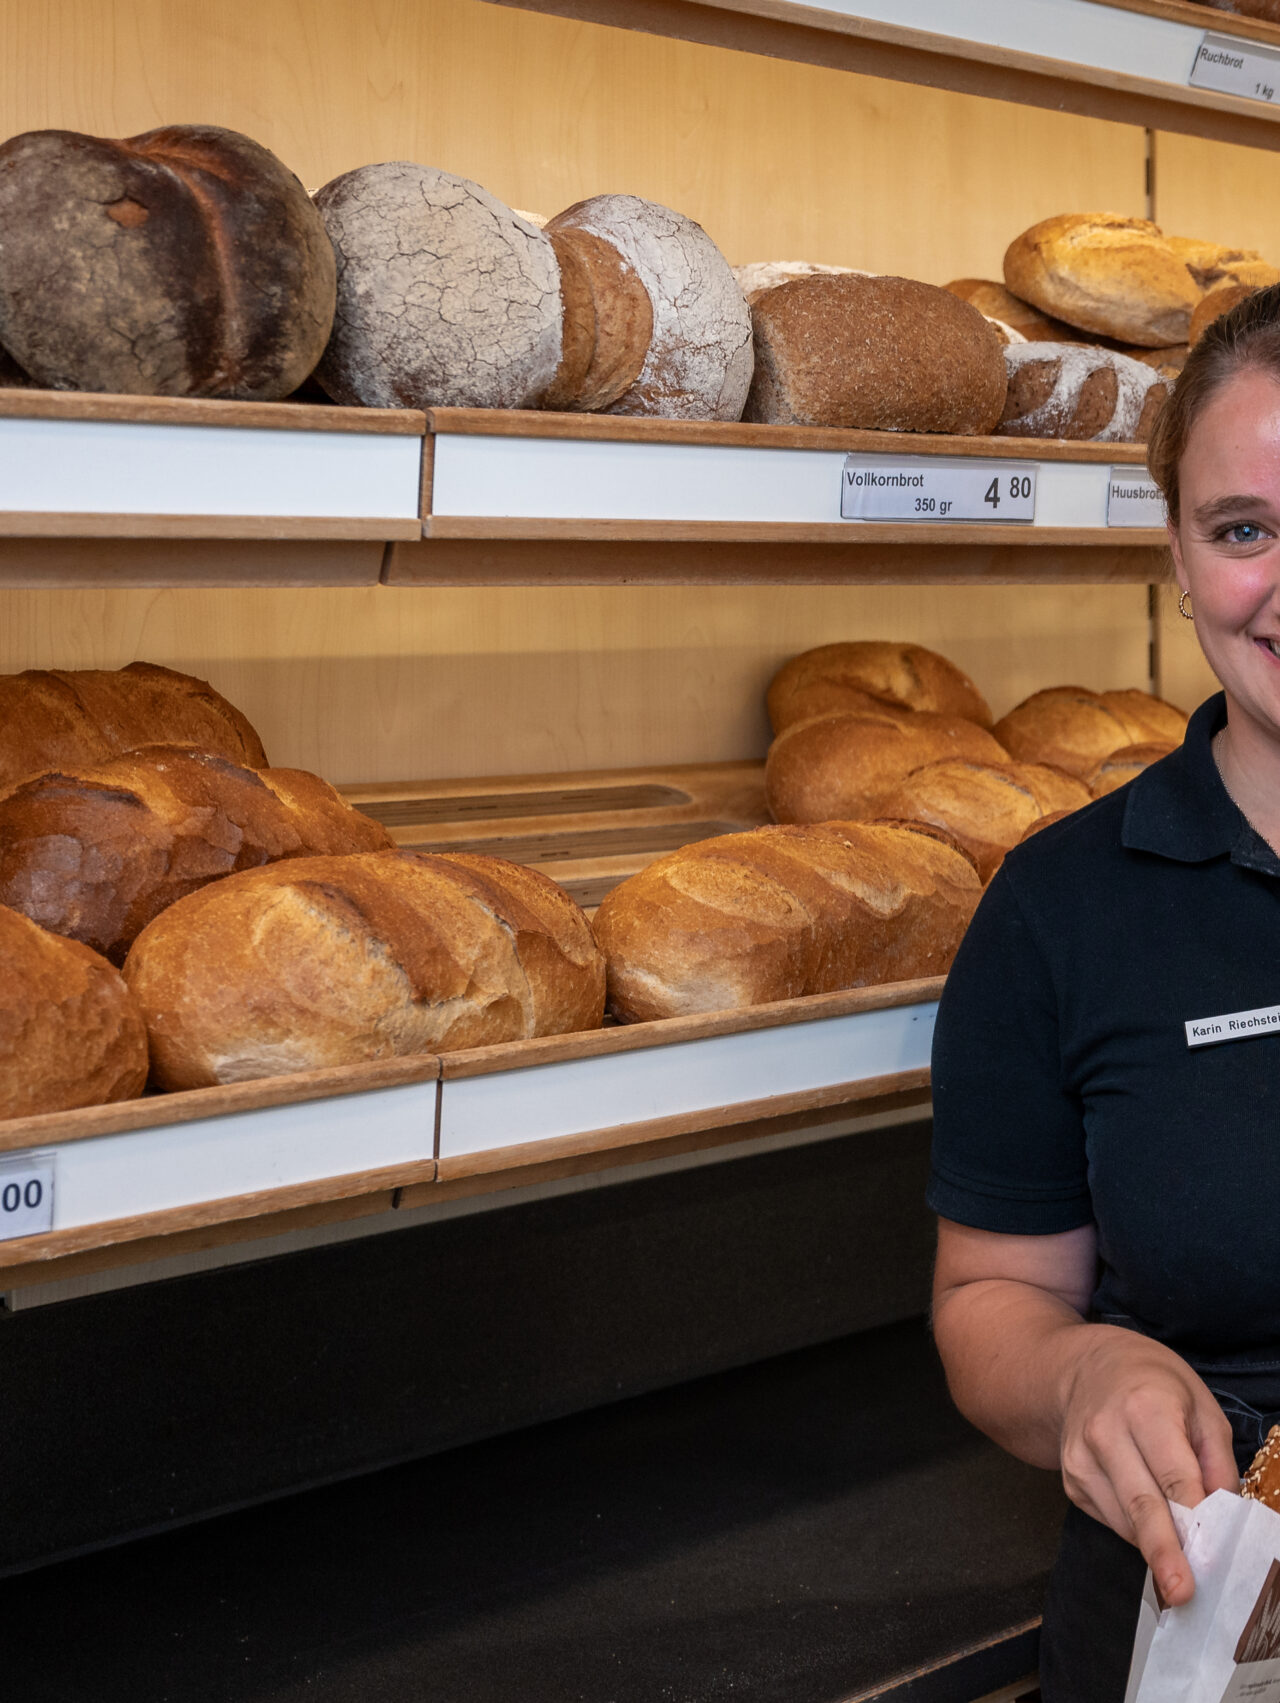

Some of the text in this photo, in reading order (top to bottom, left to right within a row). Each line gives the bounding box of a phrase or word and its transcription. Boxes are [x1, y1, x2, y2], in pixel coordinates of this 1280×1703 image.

[1200, 48, 1244, 69] Ruchbrot
[1255, 83, 1274, 99] 1 kg
[847, 472, 924, 487] Vollkornbrot
[984, 476, 1032, 508] 4 80
[914, 498, 953, 515] 350 gr
[1192, 1024, 1222, 1037] Karin
[2, 1179, 42, 1213] 00
